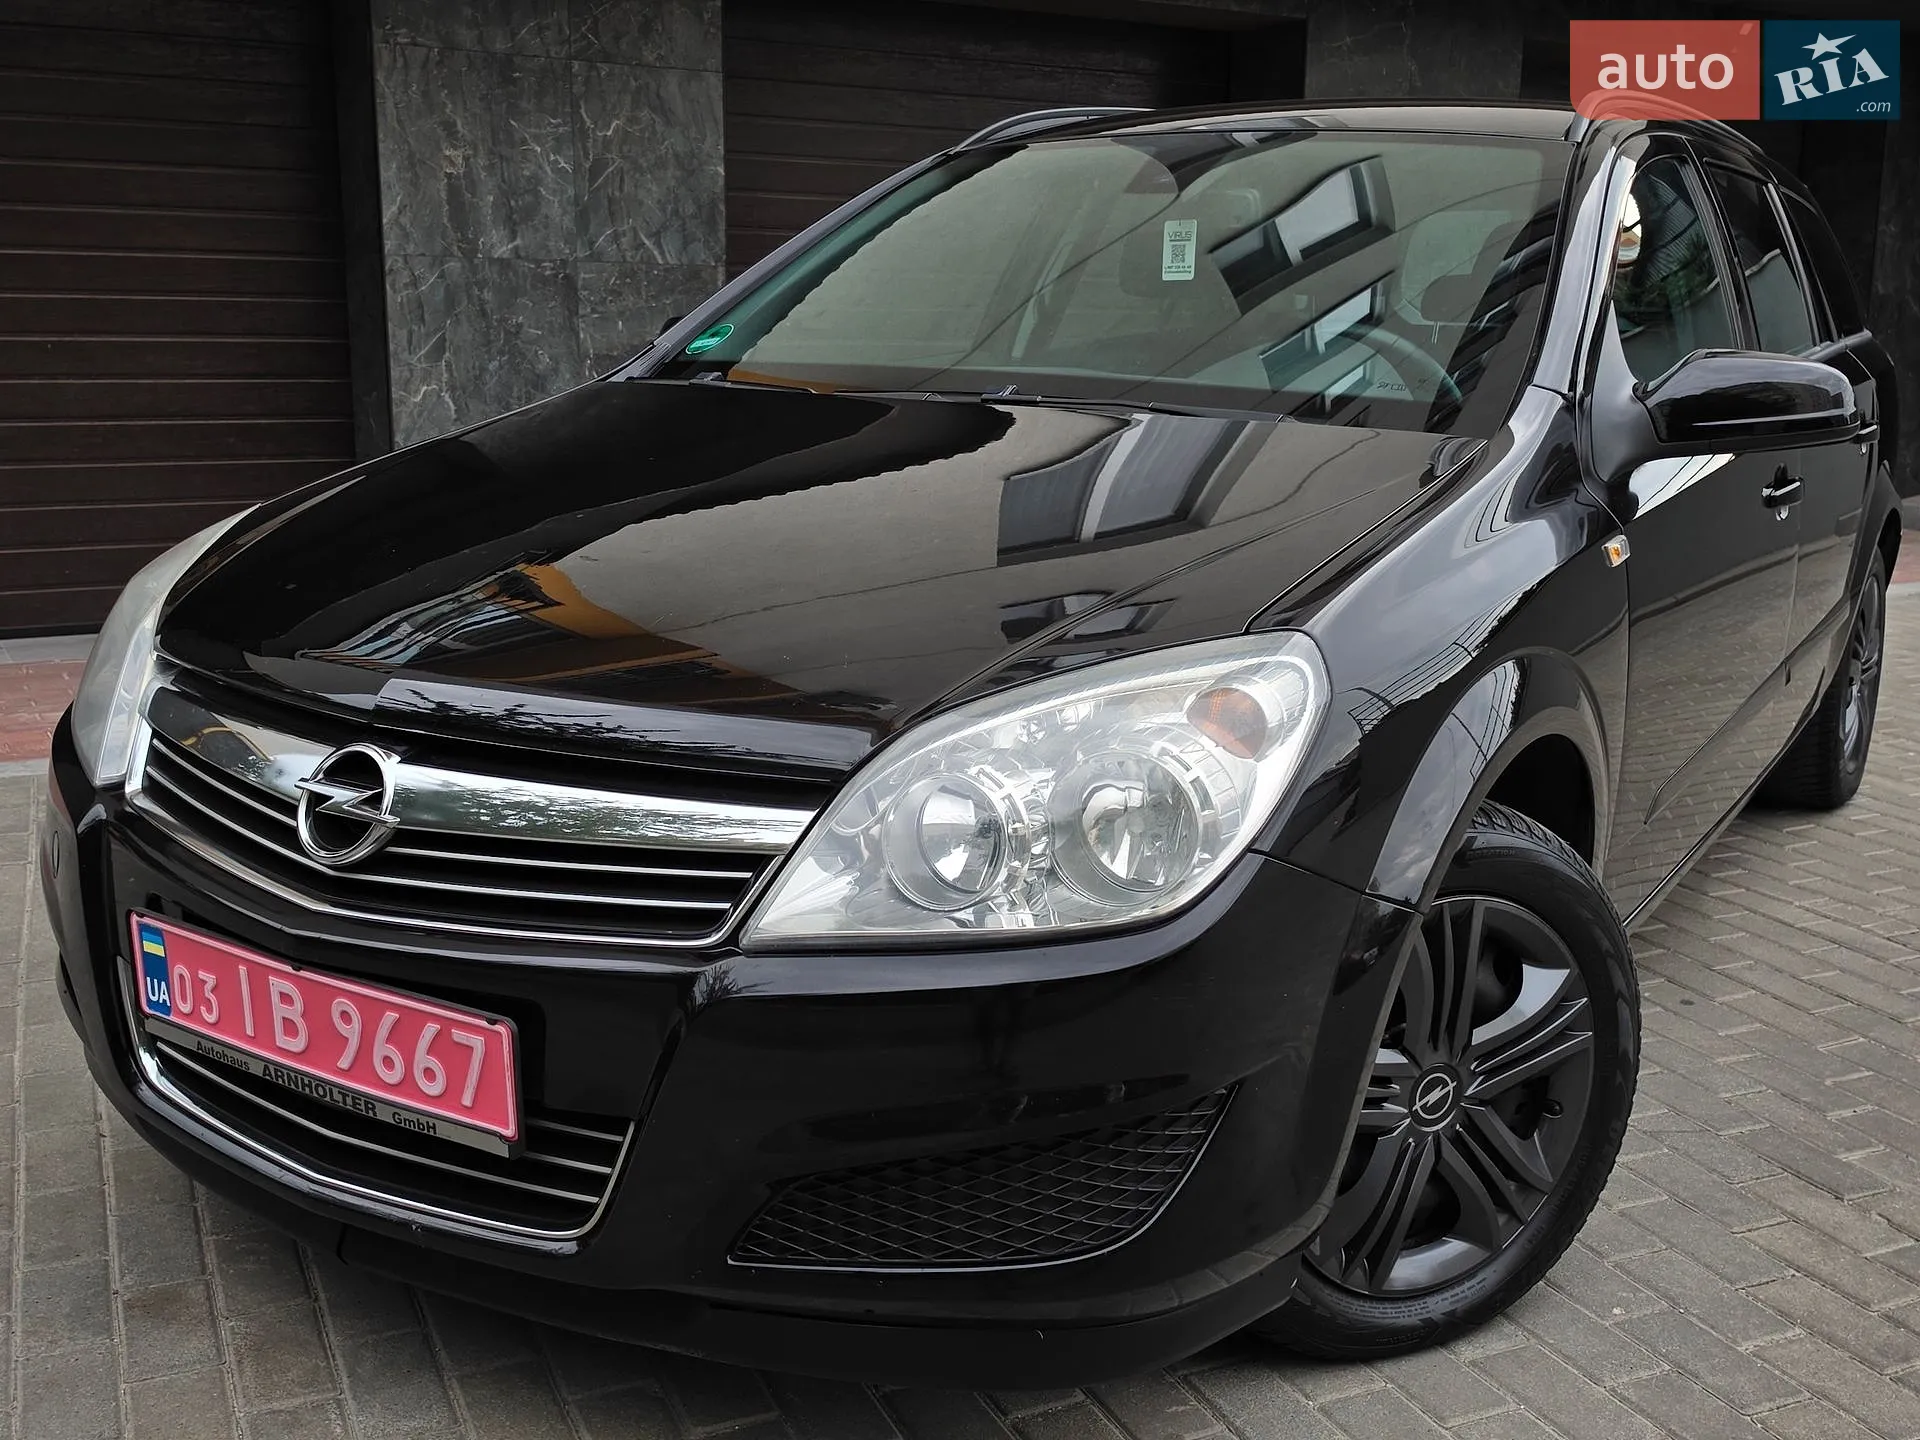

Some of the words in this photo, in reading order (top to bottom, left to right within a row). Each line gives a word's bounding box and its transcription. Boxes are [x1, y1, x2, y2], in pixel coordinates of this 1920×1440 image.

[146, 978, 171, 1006] UA
[172, 964, 220, 1025] 03
[330, 998, 486, 1109] 9667
[196, 1040, 251, 1072] Autohaus
[261, 1063, 378, 1118] ARNHOLTER
[391, 1110, 438, 1136] GmbH
